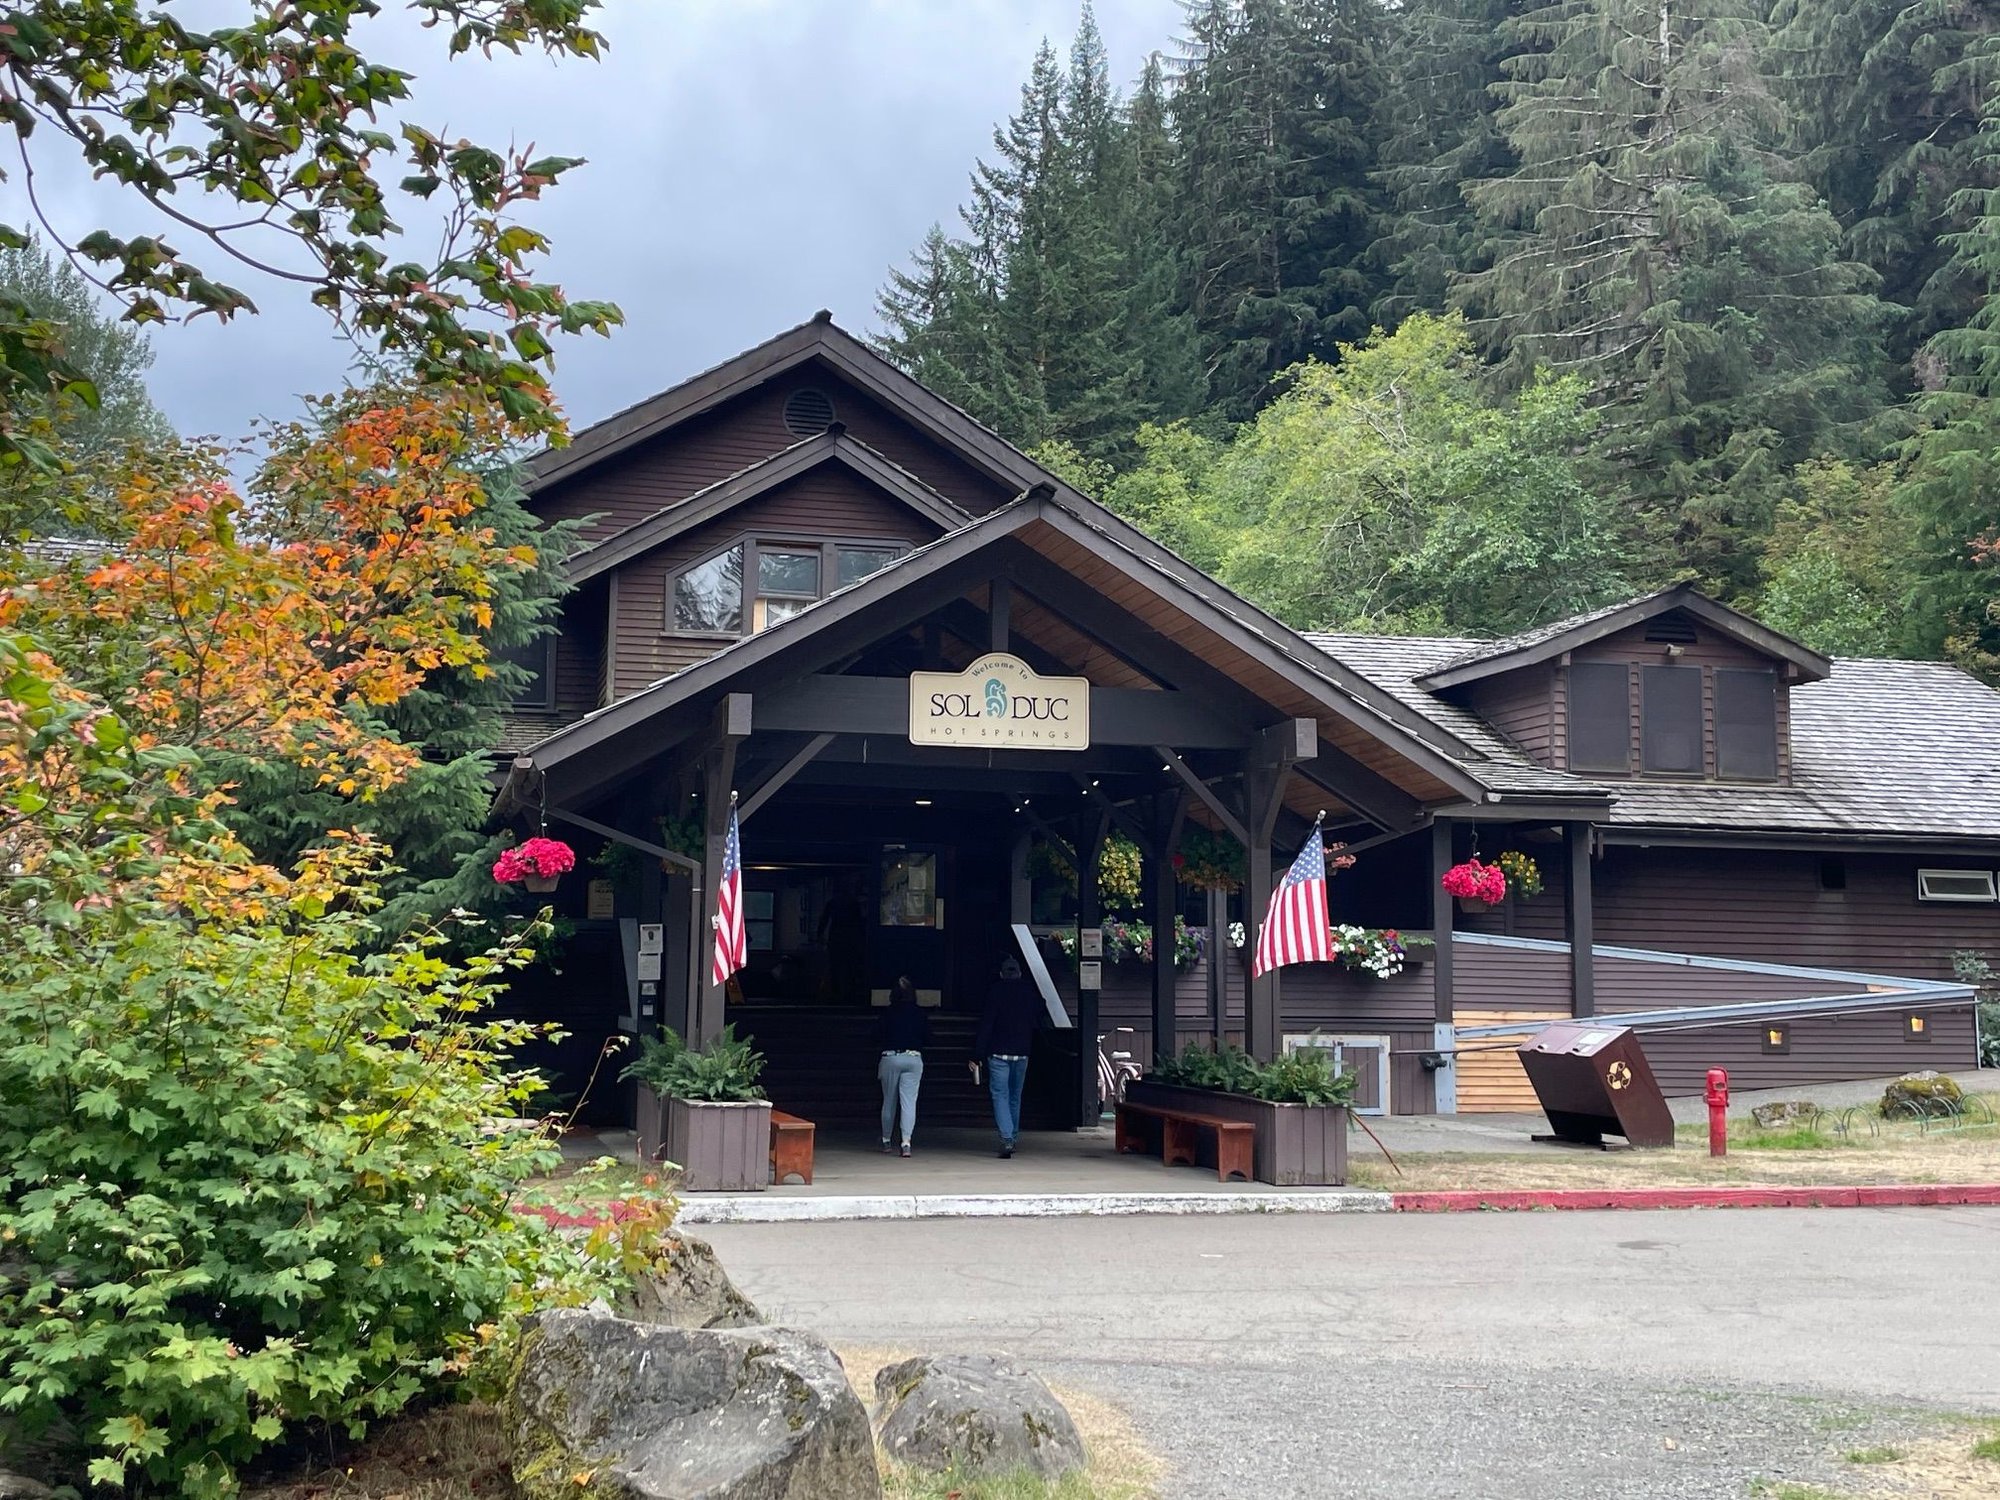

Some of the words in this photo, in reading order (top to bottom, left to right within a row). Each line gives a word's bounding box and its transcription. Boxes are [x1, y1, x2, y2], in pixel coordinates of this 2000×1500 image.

[972, 662, 1014, 677] Welcome
[1018, 669, 1029, 680] To
[931, 694, 981, 717] SOL
[1012, 696, 1068, 720] DUC
[931, 728, 966, 736] HOT
[981, 730, 1069, 739] SPRINGS
